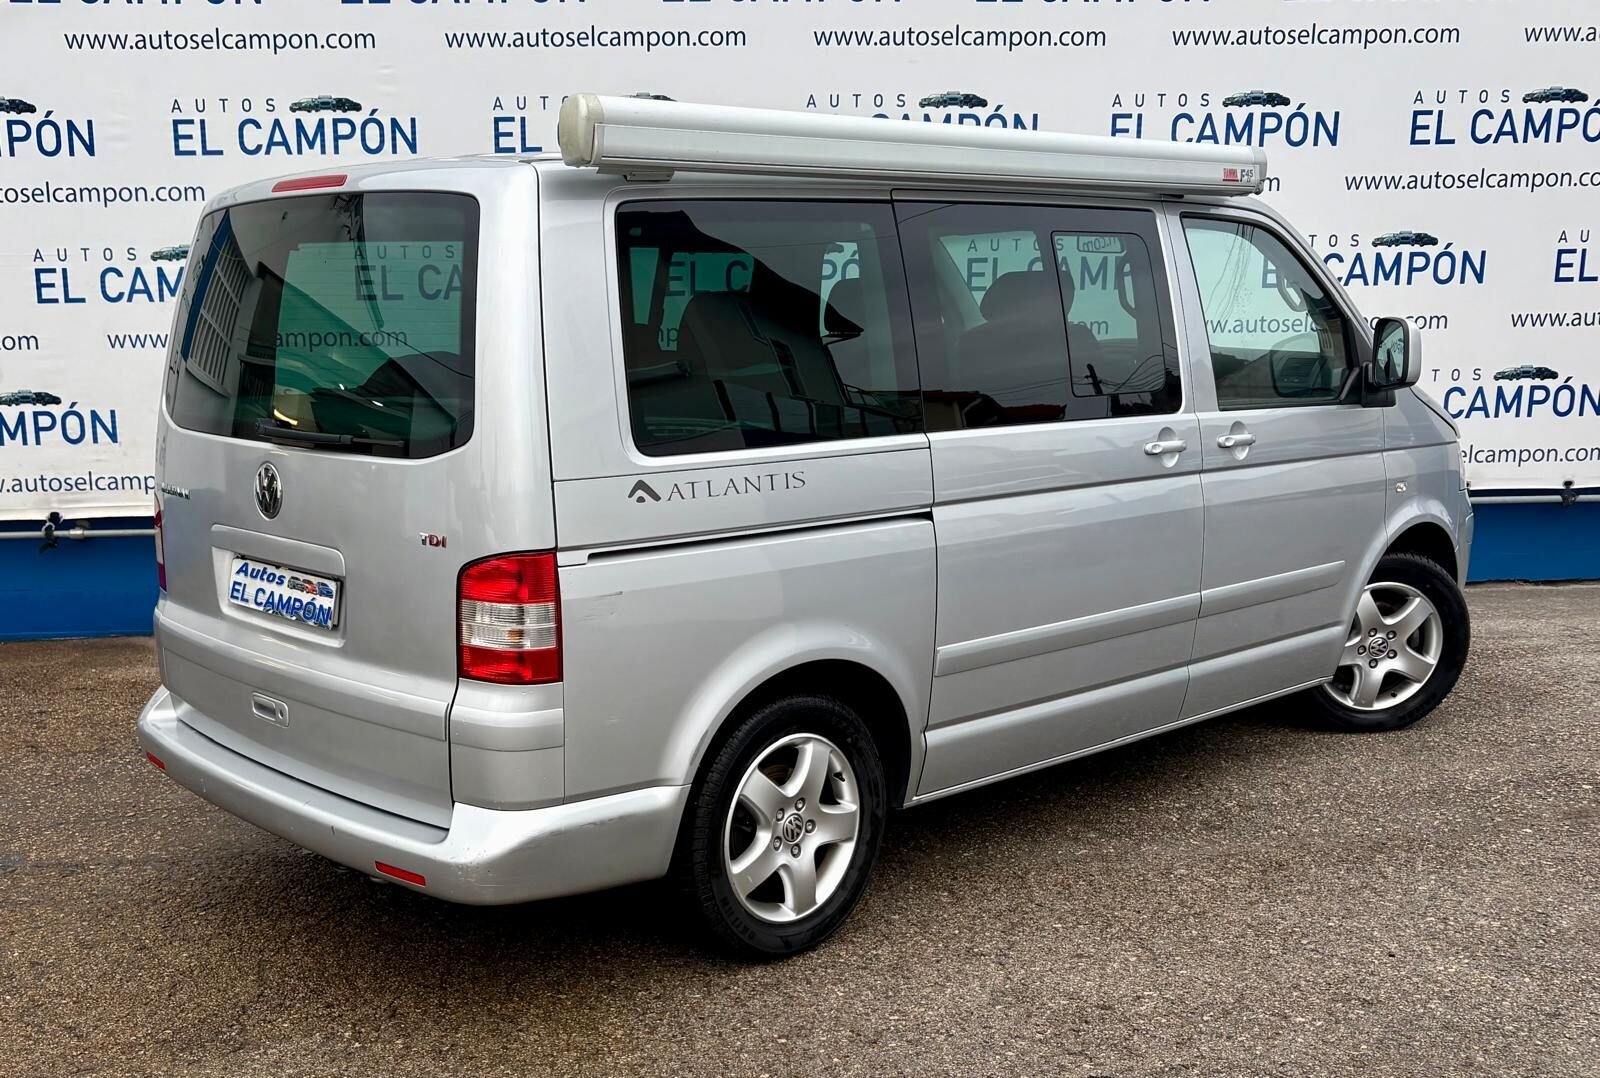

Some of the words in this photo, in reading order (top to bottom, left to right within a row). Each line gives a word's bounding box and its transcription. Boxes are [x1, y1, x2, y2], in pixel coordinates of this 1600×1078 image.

[64, 27, 376, 55] www.autoselcampon.com
[445, 25, 747, 52] www.autoselcampon.com
[813, 24, 1107, 52] www.autoselcampon.com
[1172, 23, 1460, 49] www.autoselcampon.com
[1524, 25, 1600, 43] www.a
[171, 98, 277, 114] AUTOS
[493, 96, 568, 111] AUT
[806, 93, 907, 109] AUTOS
[1111, 93, 1210, 108] AUTOS
[1413, 89, 1511, 105] AUTOS
[0, 110, 96, 157] PÓN
[172, 118, 225, 157] EL
[237, 109, 419, 156] CAMPÓN
[493, 116, 543, 154] EL
[1171, 103, 1341, 147] CAMPÓN
[1409, 109, 1456, 146] EL
[33, 247, 138, 262] AUTOS
[354, 245, 455, 260] AUTOS
[1553, 247, 1599, 283] EL
[34, 267, 87, 304] EL
[354, 264, 404, 301] EL
[1511, 312, 1600, 328] www.au
[0, 334, 39, 350] om
[666, 471, 806, 501] ATLANTIS
[419, 531, 448, 549] TDI
[235, 561, 287, 586] Autos
[230, 580, 249, 603] EL
[253, 588, 332, 625] CAMPÓN
